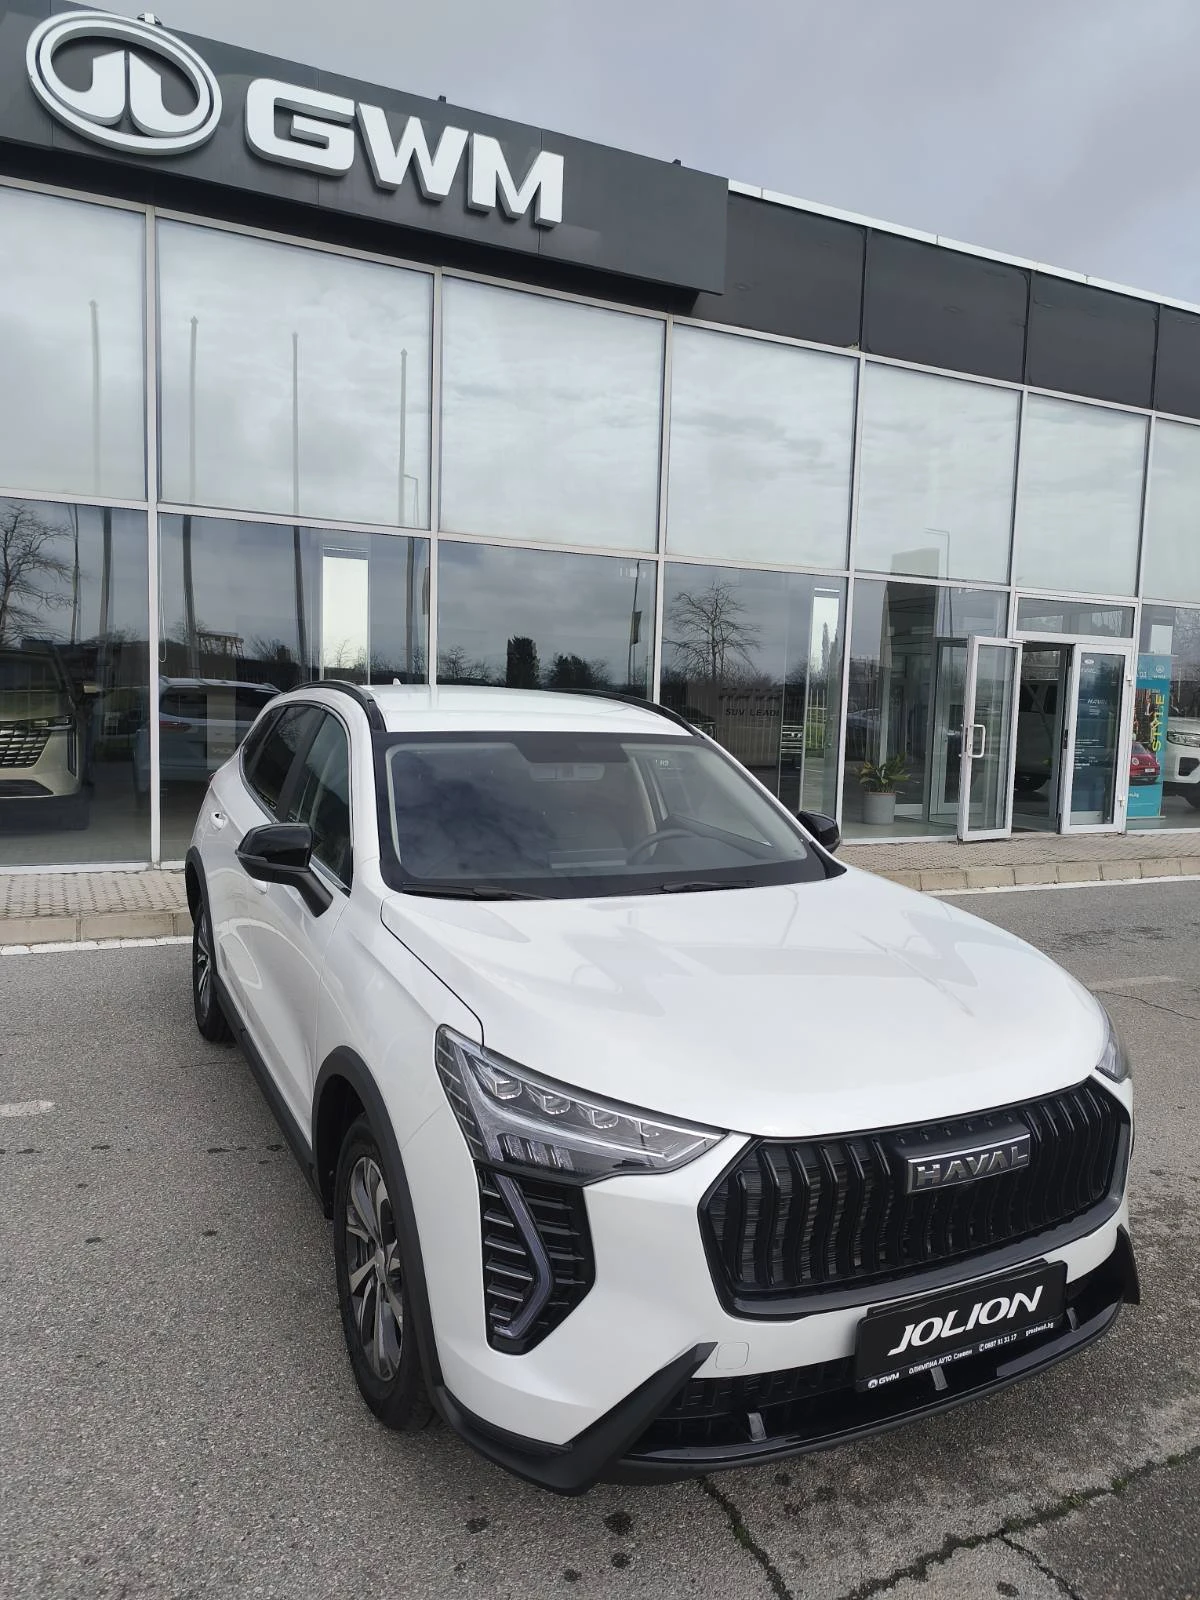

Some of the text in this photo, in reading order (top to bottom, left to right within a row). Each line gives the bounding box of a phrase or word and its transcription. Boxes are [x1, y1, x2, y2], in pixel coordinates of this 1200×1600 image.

[245, 78, 564, 227] GWM
[726, 708, 780, 717] SUV LEAD
[1150, 694, 1165, 752] STYLE
[917, 1146, 1028, 1187] HAVAL
[887, 1285, 1043, 1356] JOLION
[878, 1372, 900, 1385] GWM
